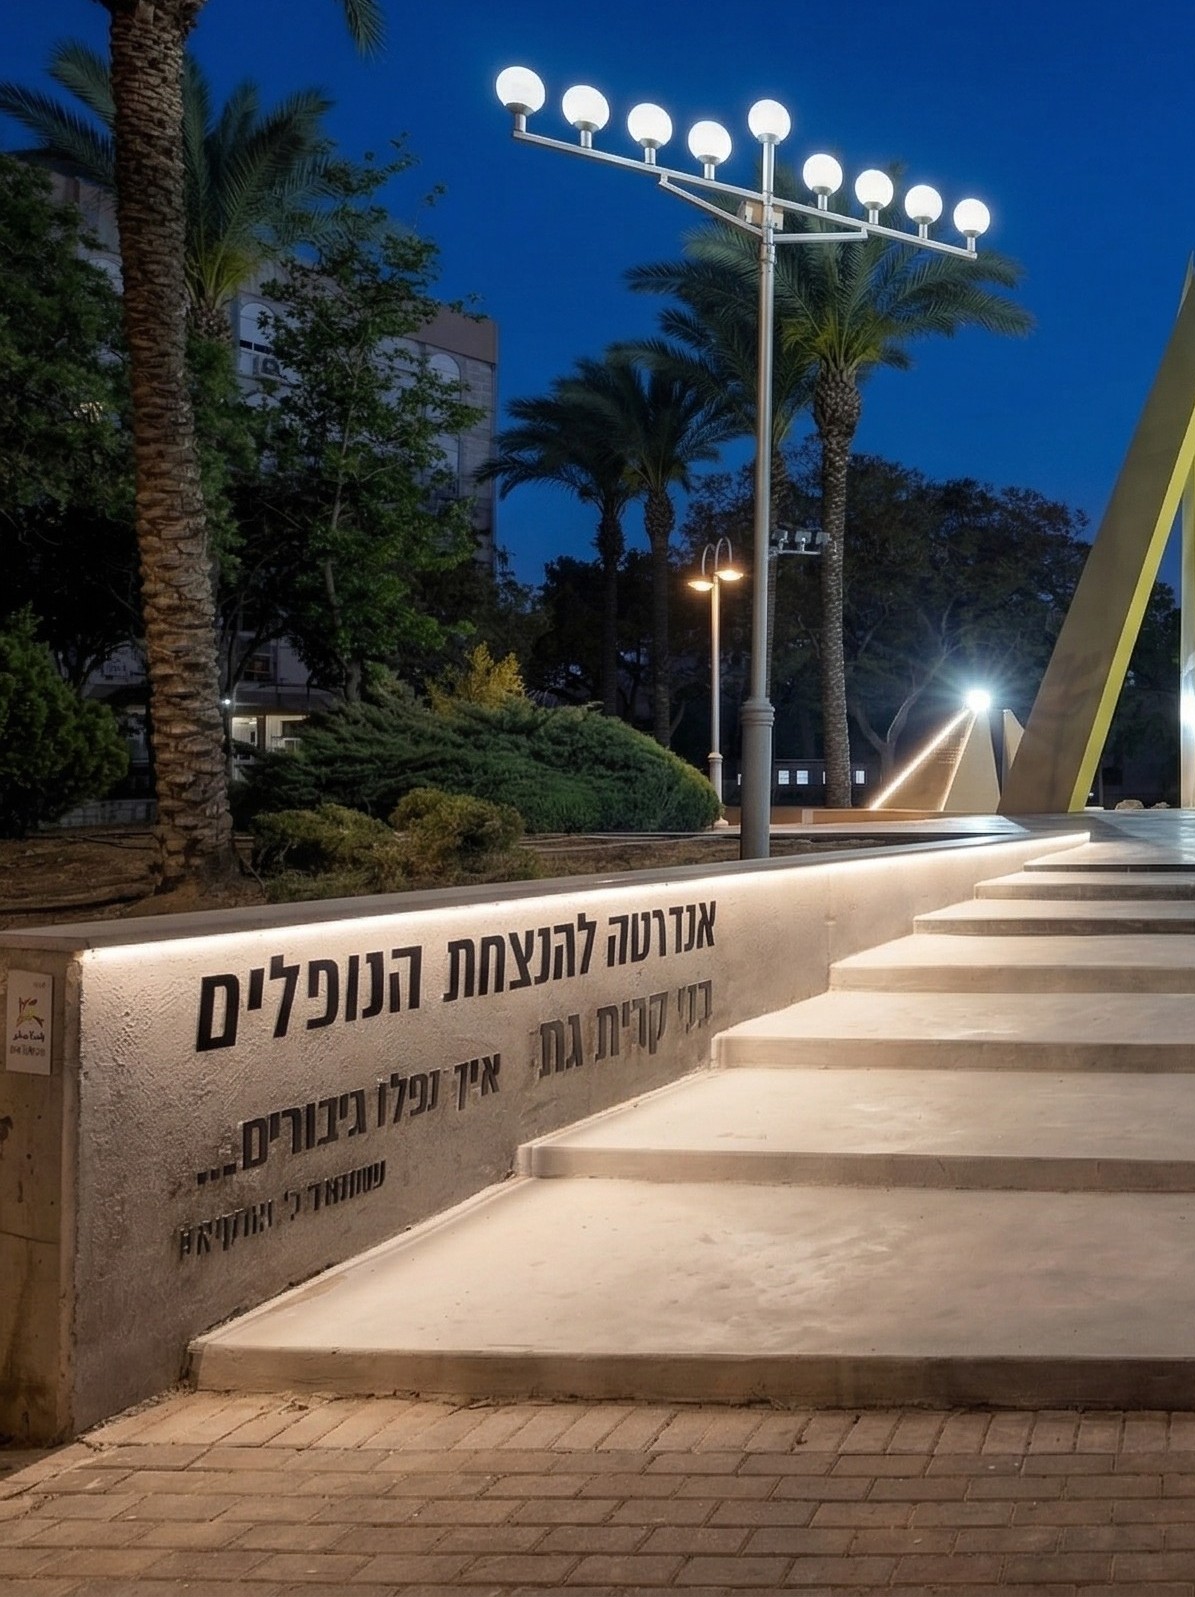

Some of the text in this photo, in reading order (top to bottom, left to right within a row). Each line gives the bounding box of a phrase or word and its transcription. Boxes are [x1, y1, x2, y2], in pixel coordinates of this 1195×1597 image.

[196, 900, 716, 1053] אנדרטה להנצחת הנופלים
[538, 1013, 583, 1078] גת
[595, 991, 669, 1062] קרית
[377, 1068, 441, 1128] נפלו
[454, 1053, 501, 1112] איך
